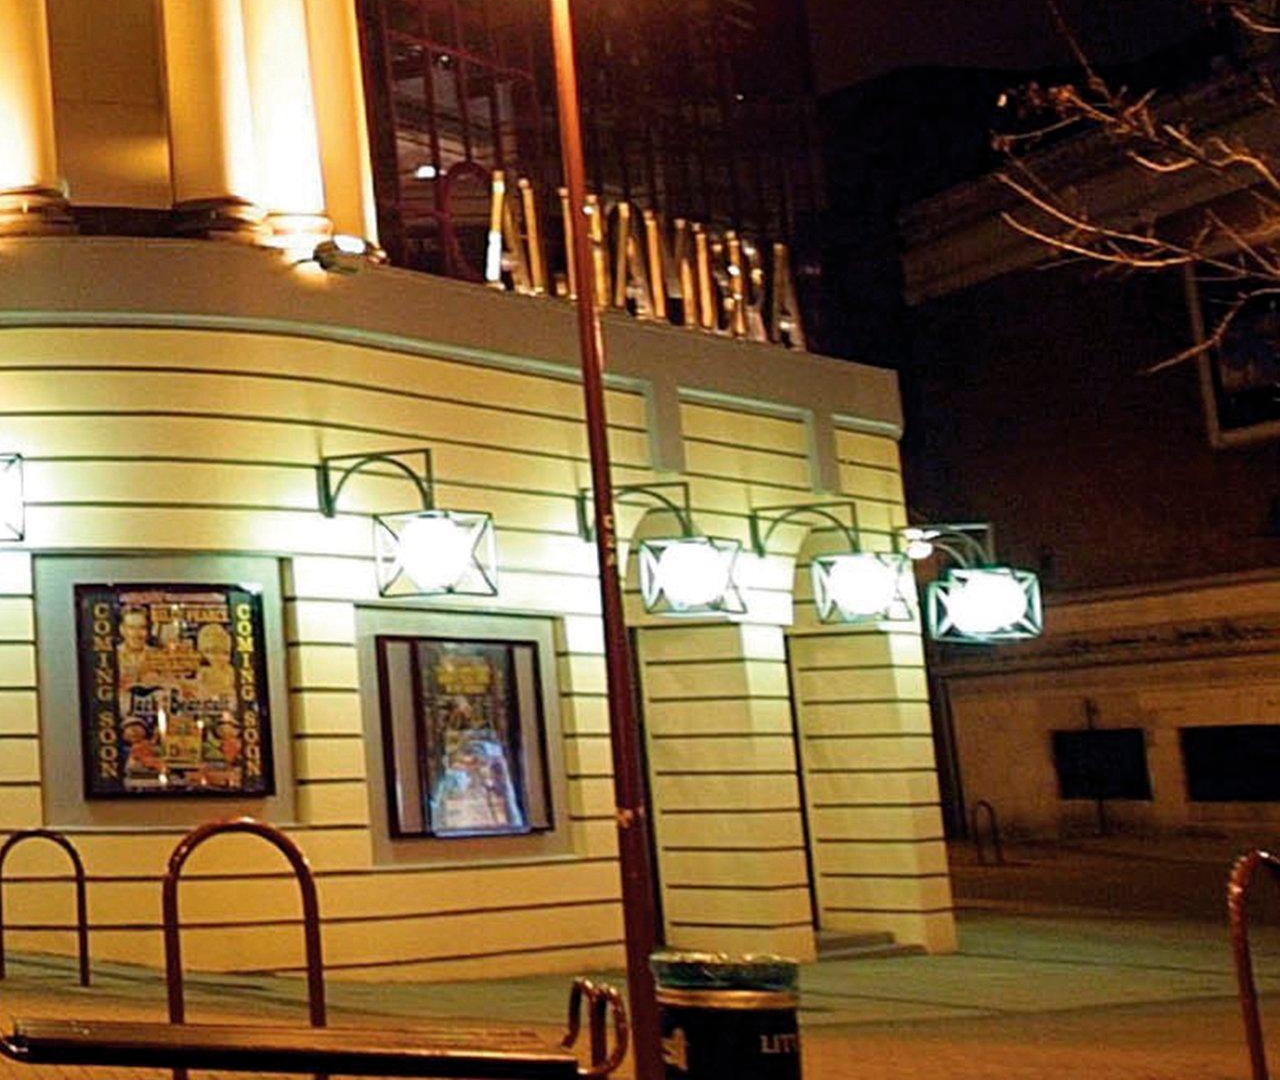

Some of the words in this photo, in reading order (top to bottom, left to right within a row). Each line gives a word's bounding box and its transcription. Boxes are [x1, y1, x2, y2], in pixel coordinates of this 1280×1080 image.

[93, 602, 115, 702] COMING
[236, 602, 256, 702] COMING
[97, 710, 118, 779] SOON
[242, 709, 262, 776] SOON
[760, 1033, 798, 1054] LIT
